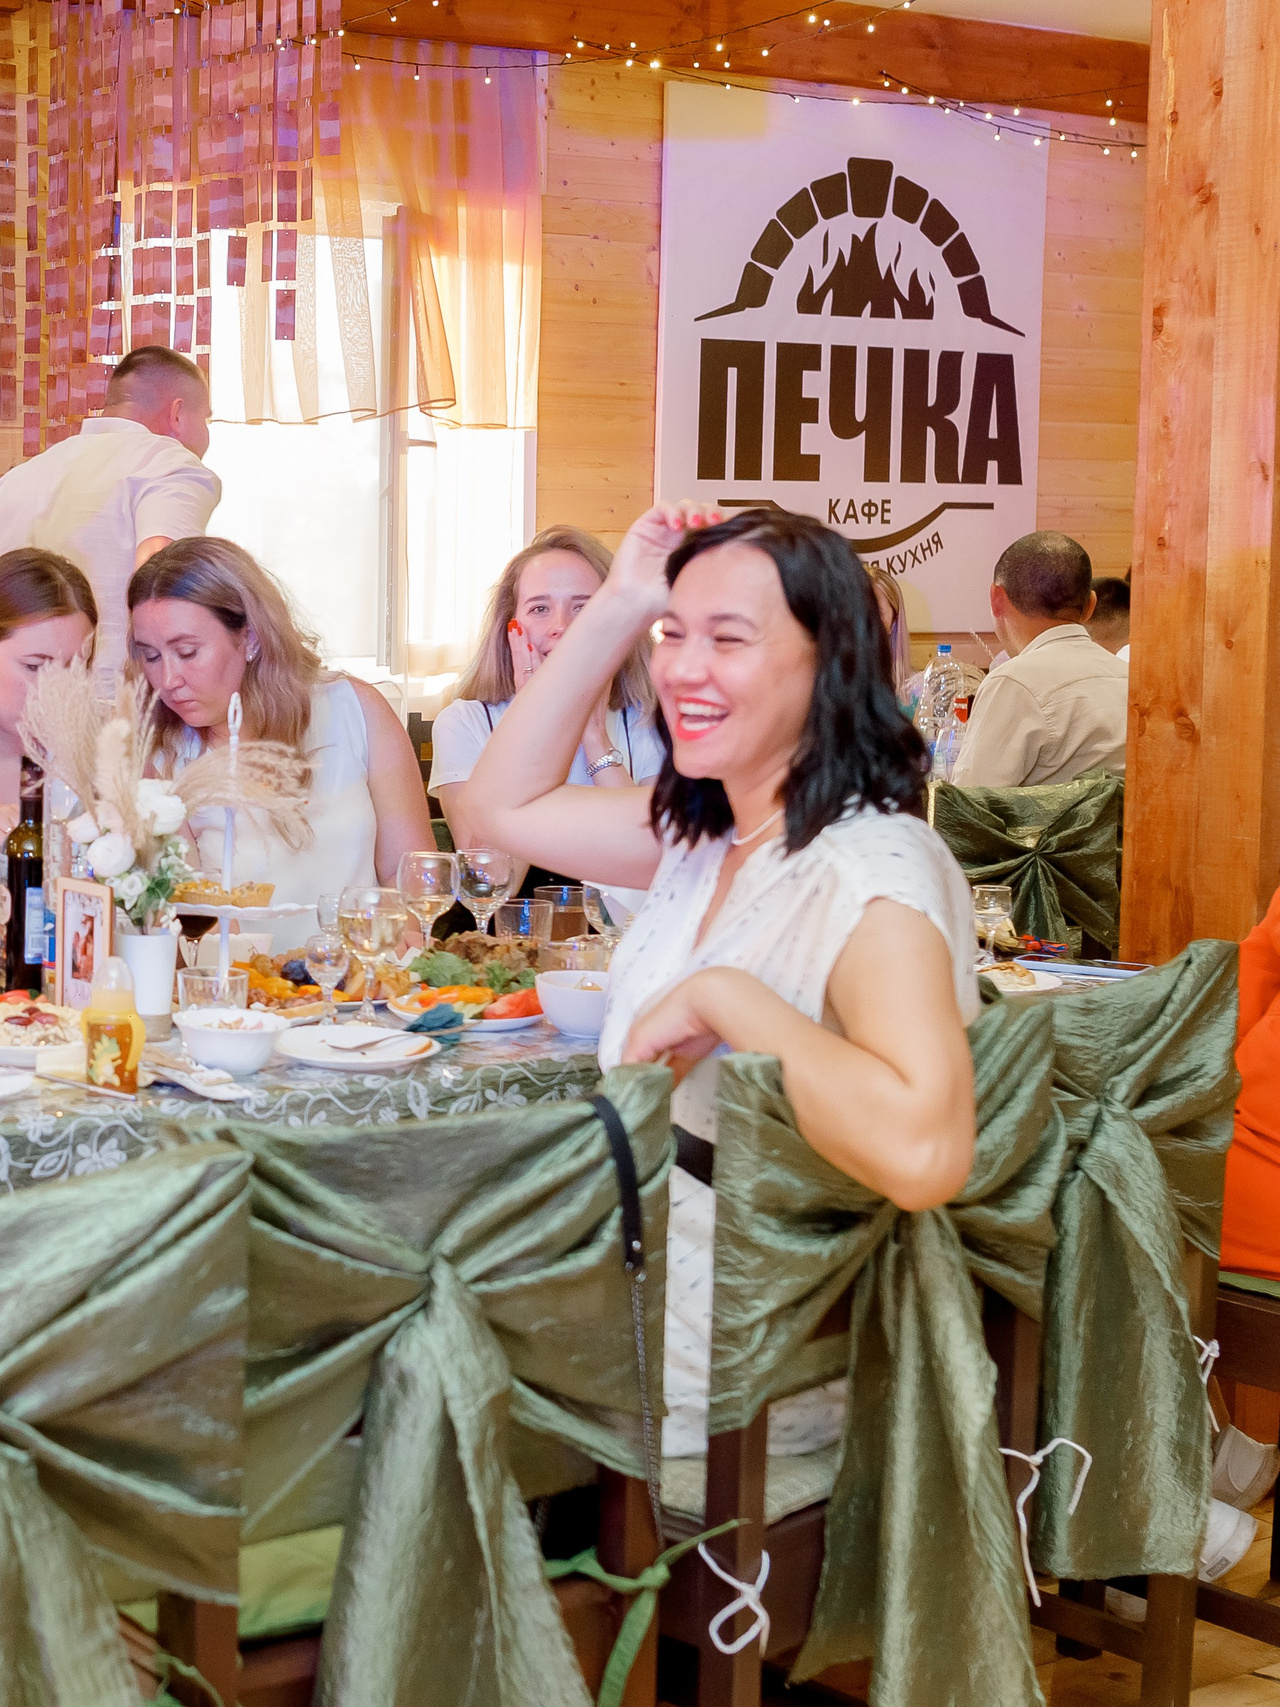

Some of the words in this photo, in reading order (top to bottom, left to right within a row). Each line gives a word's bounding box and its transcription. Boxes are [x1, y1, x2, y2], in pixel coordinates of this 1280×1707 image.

[697, 338, 1023, 485] ПЕЧКА
[828, 499, 891, 524] КАФЕ
[886, 531, 944, 576] КУХНЯ
